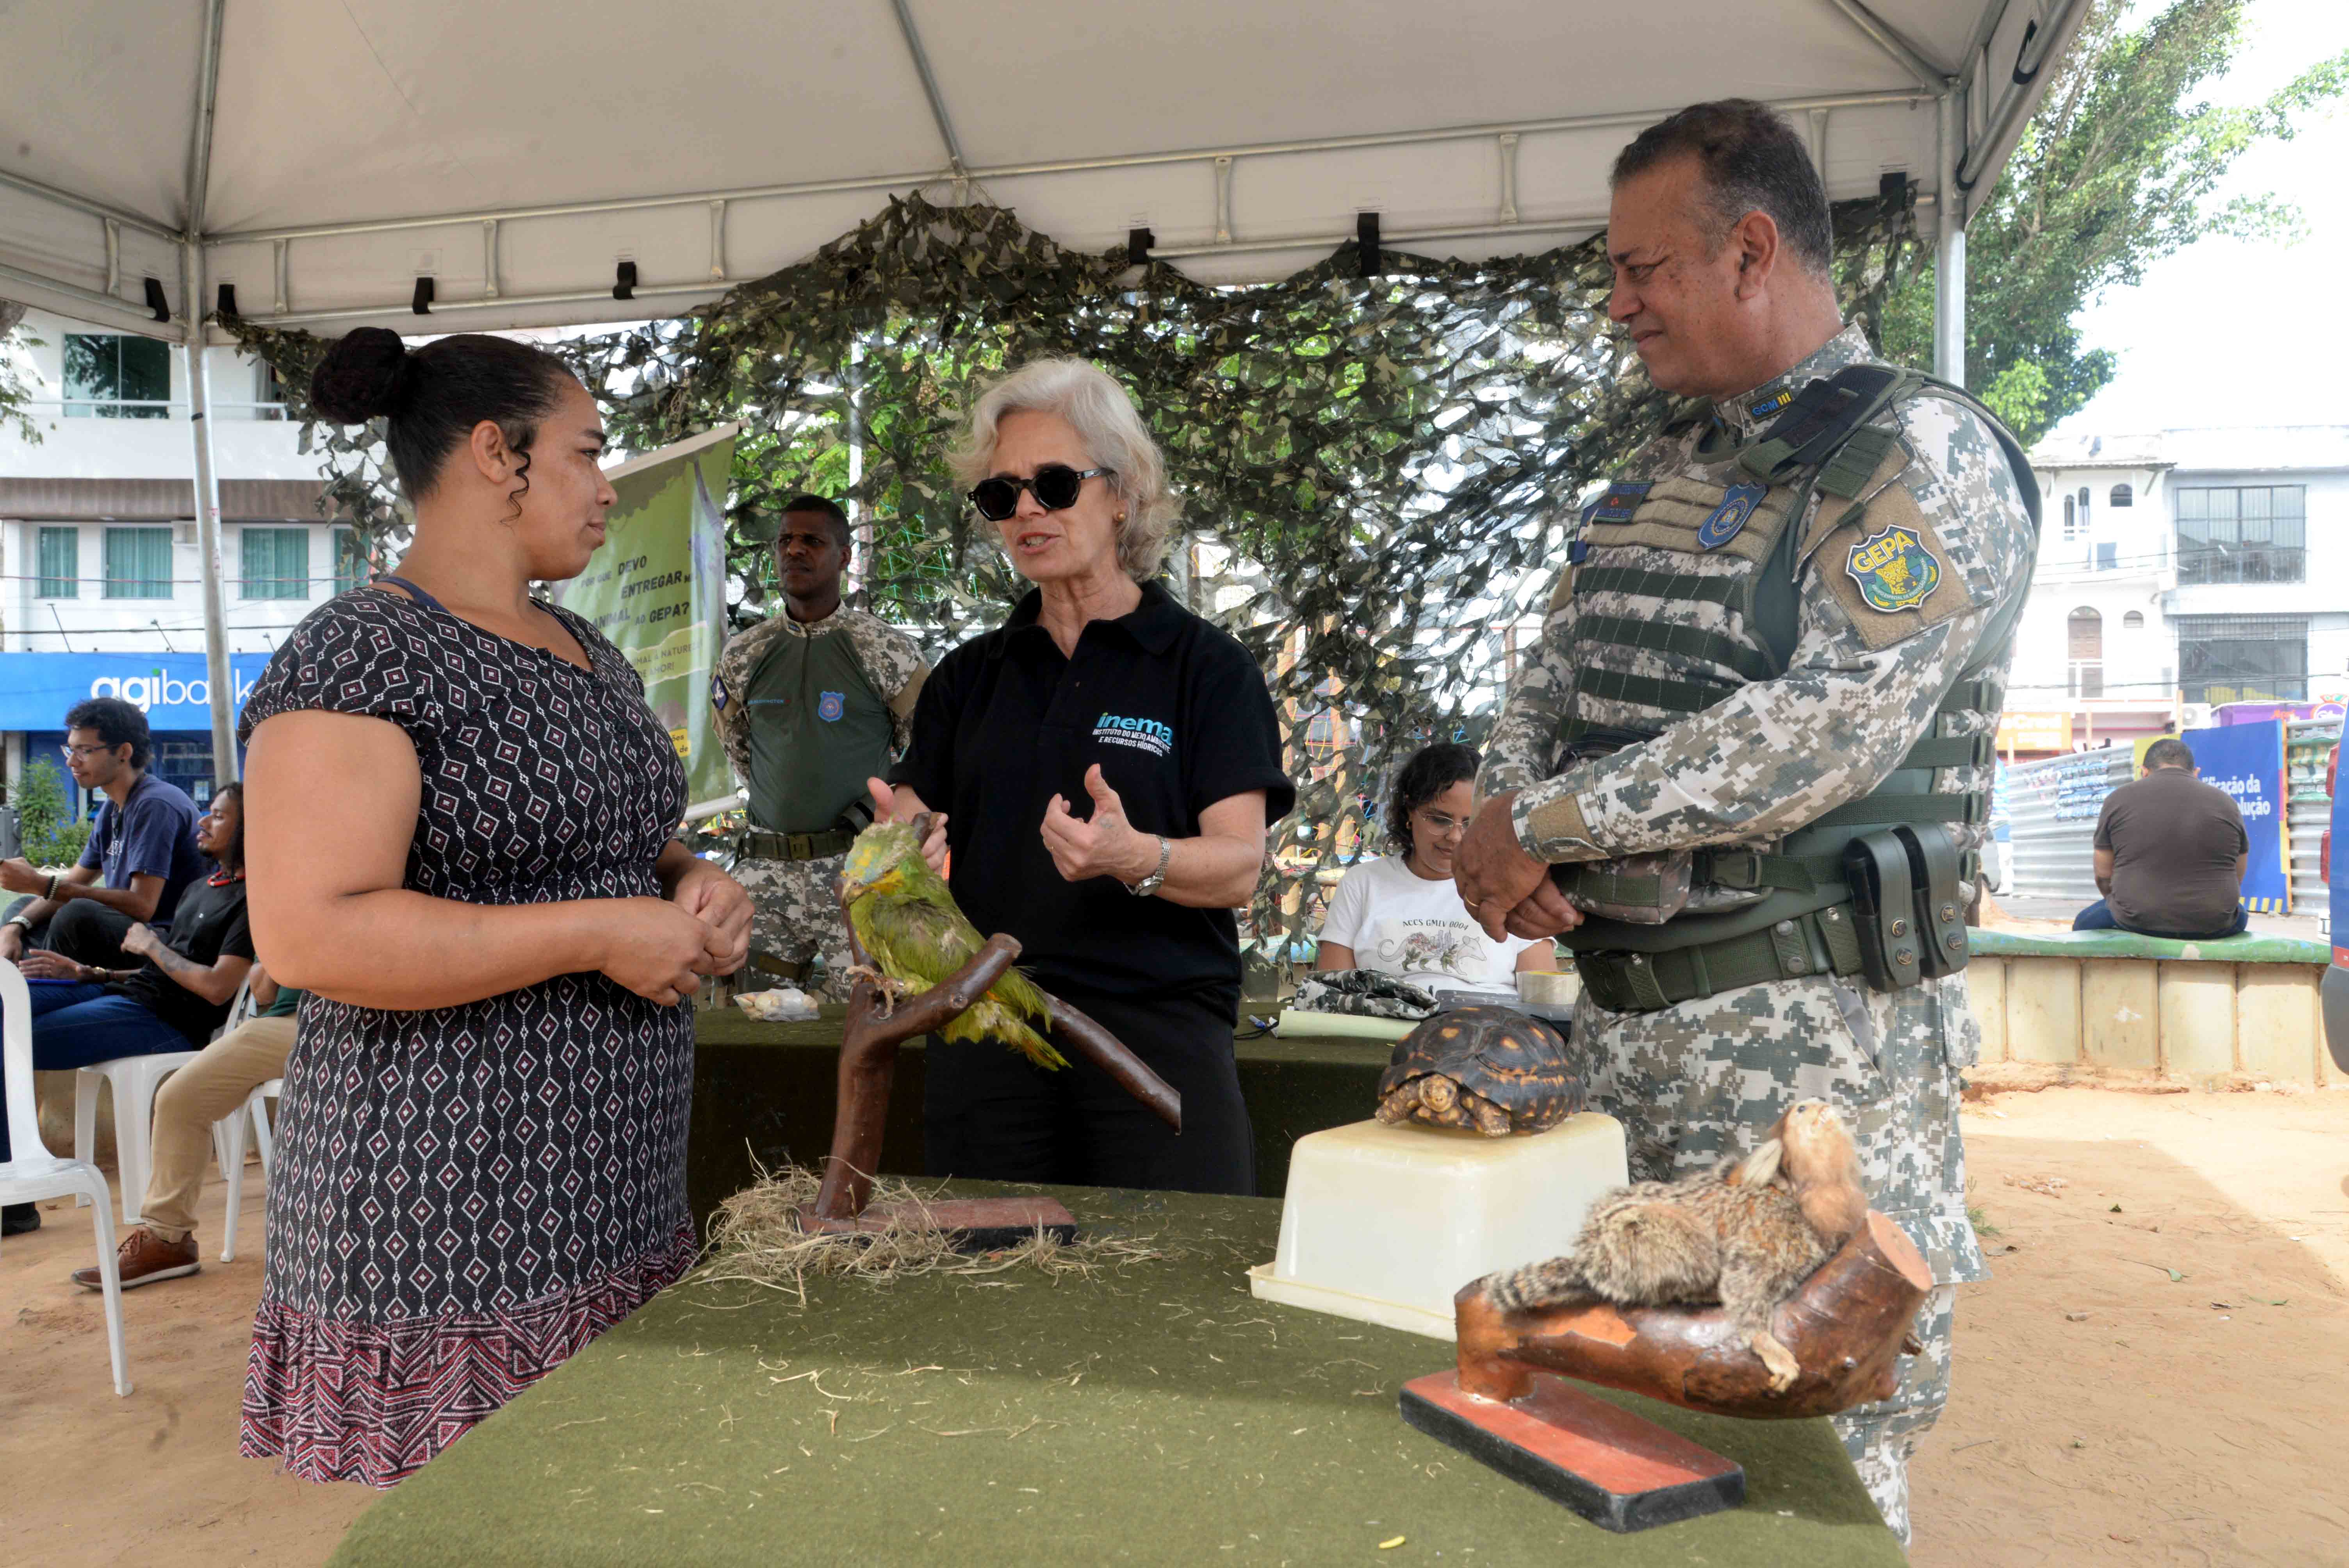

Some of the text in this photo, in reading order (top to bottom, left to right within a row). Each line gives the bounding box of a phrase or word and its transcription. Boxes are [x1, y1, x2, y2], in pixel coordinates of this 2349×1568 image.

[1752, 399, 1778, 415] GCM
[1853, 531, 1916, 573] GEPA
[618, 556, 647, 576] DEVO
[621, 571, 682, 599] ENTREGAR
[592, 602, 690, 629] ANIMAL AO GEPA?
[90, 668, 258, 714] agibak
[1096, 712, 1172, 746] inema
[1104, 737, 1136, 747] RECURSOS
[1137, 741, 1163, 757] HÍDRICOS
[1131, 732, 1146, 740] MEIO
[1146, 734, 1171, 754] AMBIENTE
[2246, 773, 2261, 793] da
[2237, 796, 2271, 820] lução
[1403, 919, 1424, 927] ACCS
[1449, 921, 1469, 930] 0004
